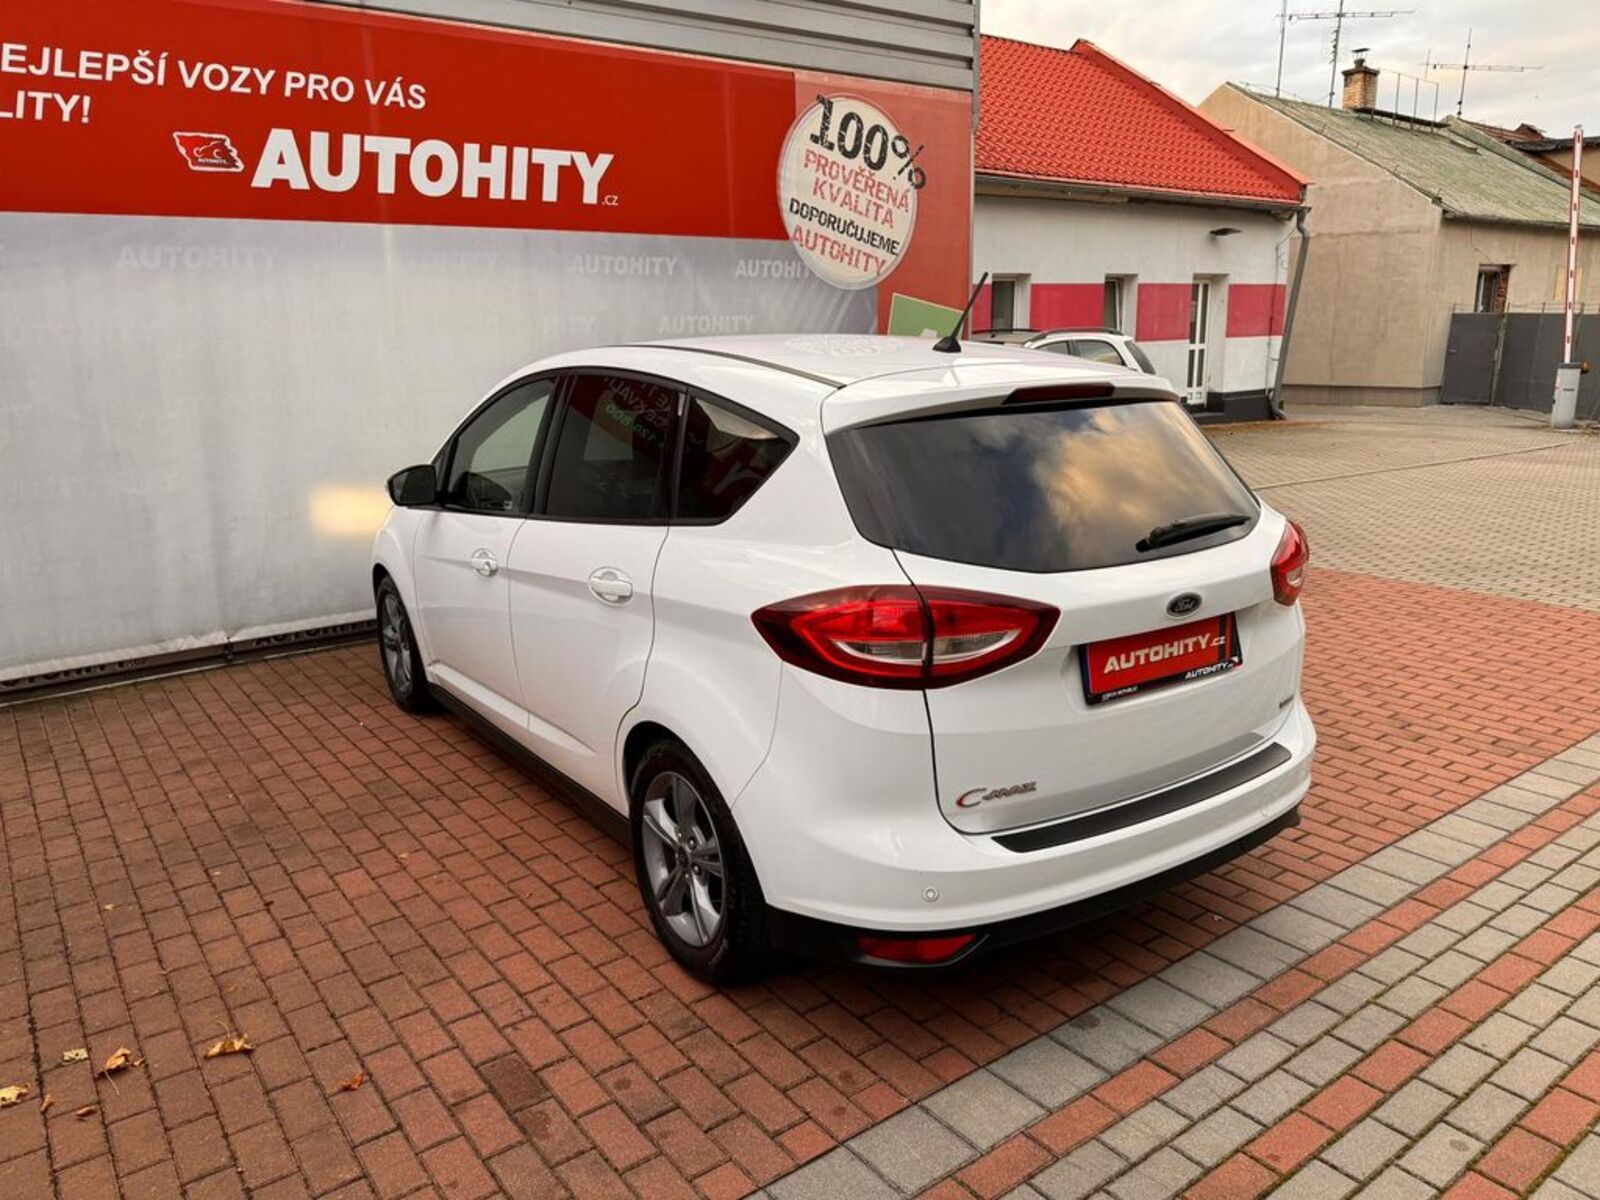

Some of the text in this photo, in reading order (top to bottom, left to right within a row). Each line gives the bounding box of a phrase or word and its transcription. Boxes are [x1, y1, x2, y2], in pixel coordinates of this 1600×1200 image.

[178, 60, 276, 95] VOZY
[284, 71, 355, 103] PRO
[364, 77, 426, 109] VÁS
[809, 94, 927, 190] 100%
[803, 149, 909, 213] PROVĚŘENÁ
[812, 177, 894, 229] KVALITA
[789, 198, 900, 256] DOPORUČUJEME
[791, 224, 887, 277] AUTOHITY
[571, 254, 679, 276] AUTOHITY
[658, 314, 754, 335] AUTOHITY
